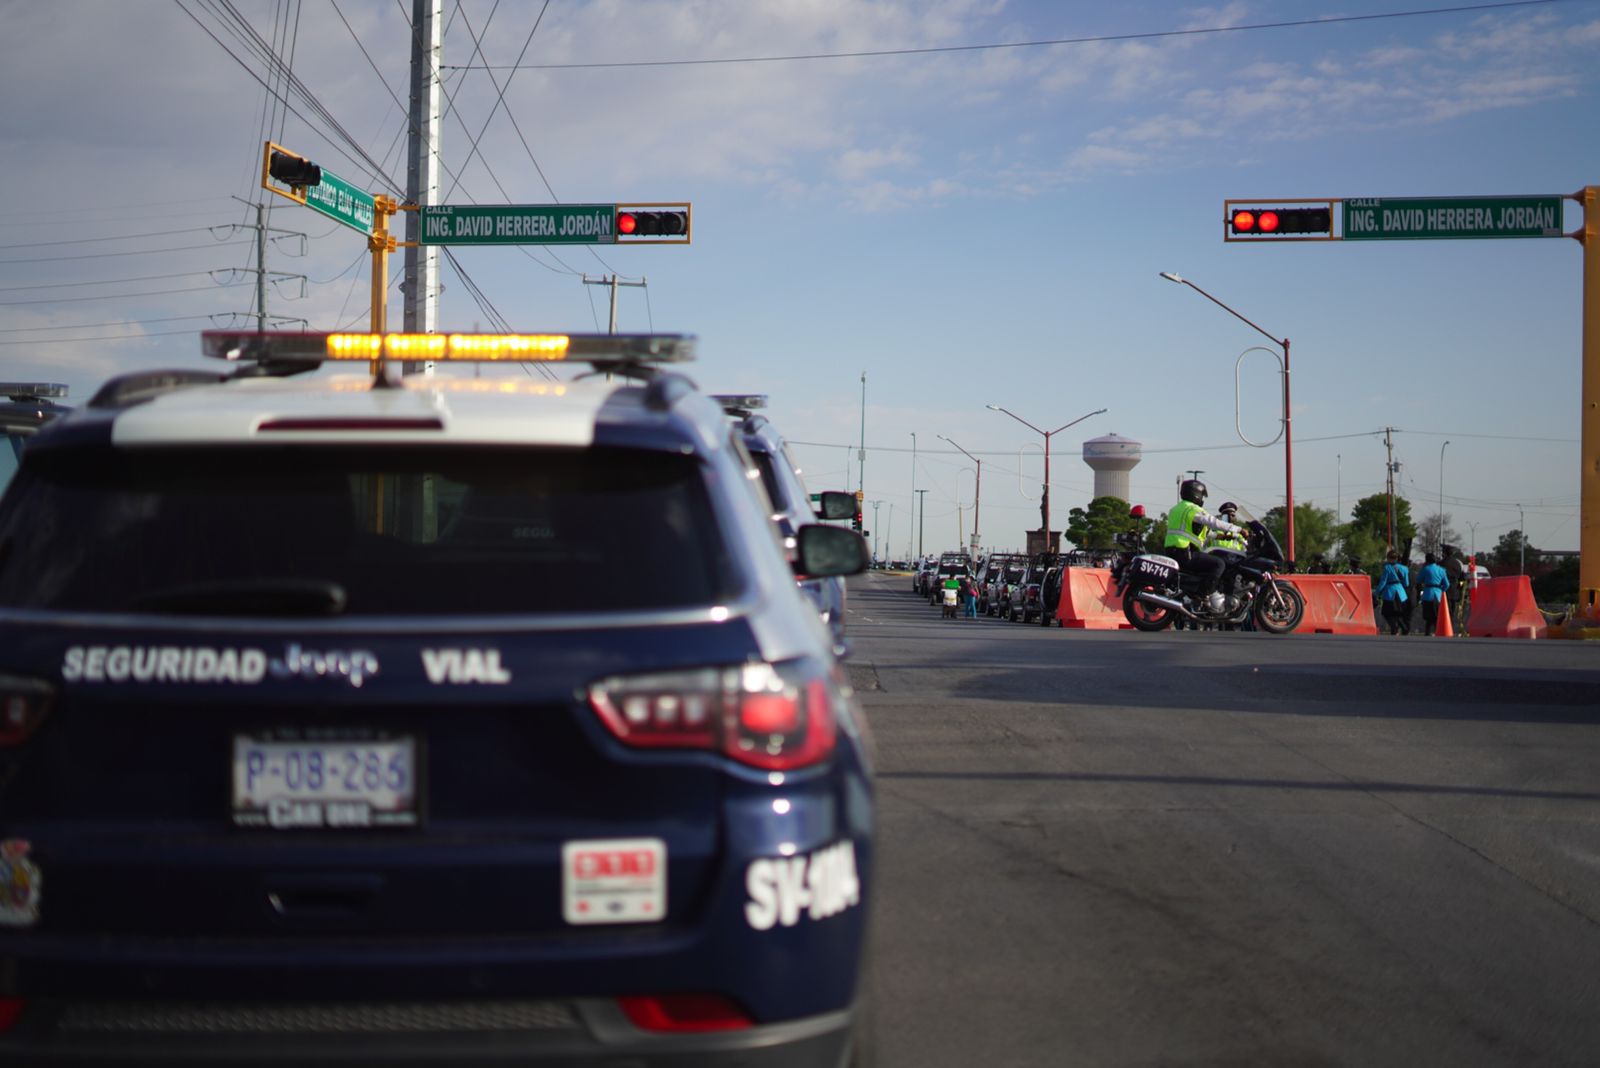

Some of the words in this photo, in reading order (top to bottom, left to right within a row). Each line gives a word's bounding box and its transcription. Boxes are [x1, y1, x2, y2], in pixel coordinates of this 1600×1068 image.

[1350, 199, 1380, 207] CALLE
[426, 216, 452, 236] ING.
[455, 216, 493, 236] DAVID
[496, 216, 556, 236] HERRERA
[559, 210, 611, 236] JORDÁN
[1350, 210, 1379, 232] ING.
[1383, 209, 1425, 231] DAVID
[1427, 207, 1493, 230] HERRERA
[1497, 202, 1554, 230] JORDÁN
[1140, 561, 1169, 578] SV-714
[62, 645, 267, 683] SEGURIDAD
[422, 648, 511, 684] VIAL
